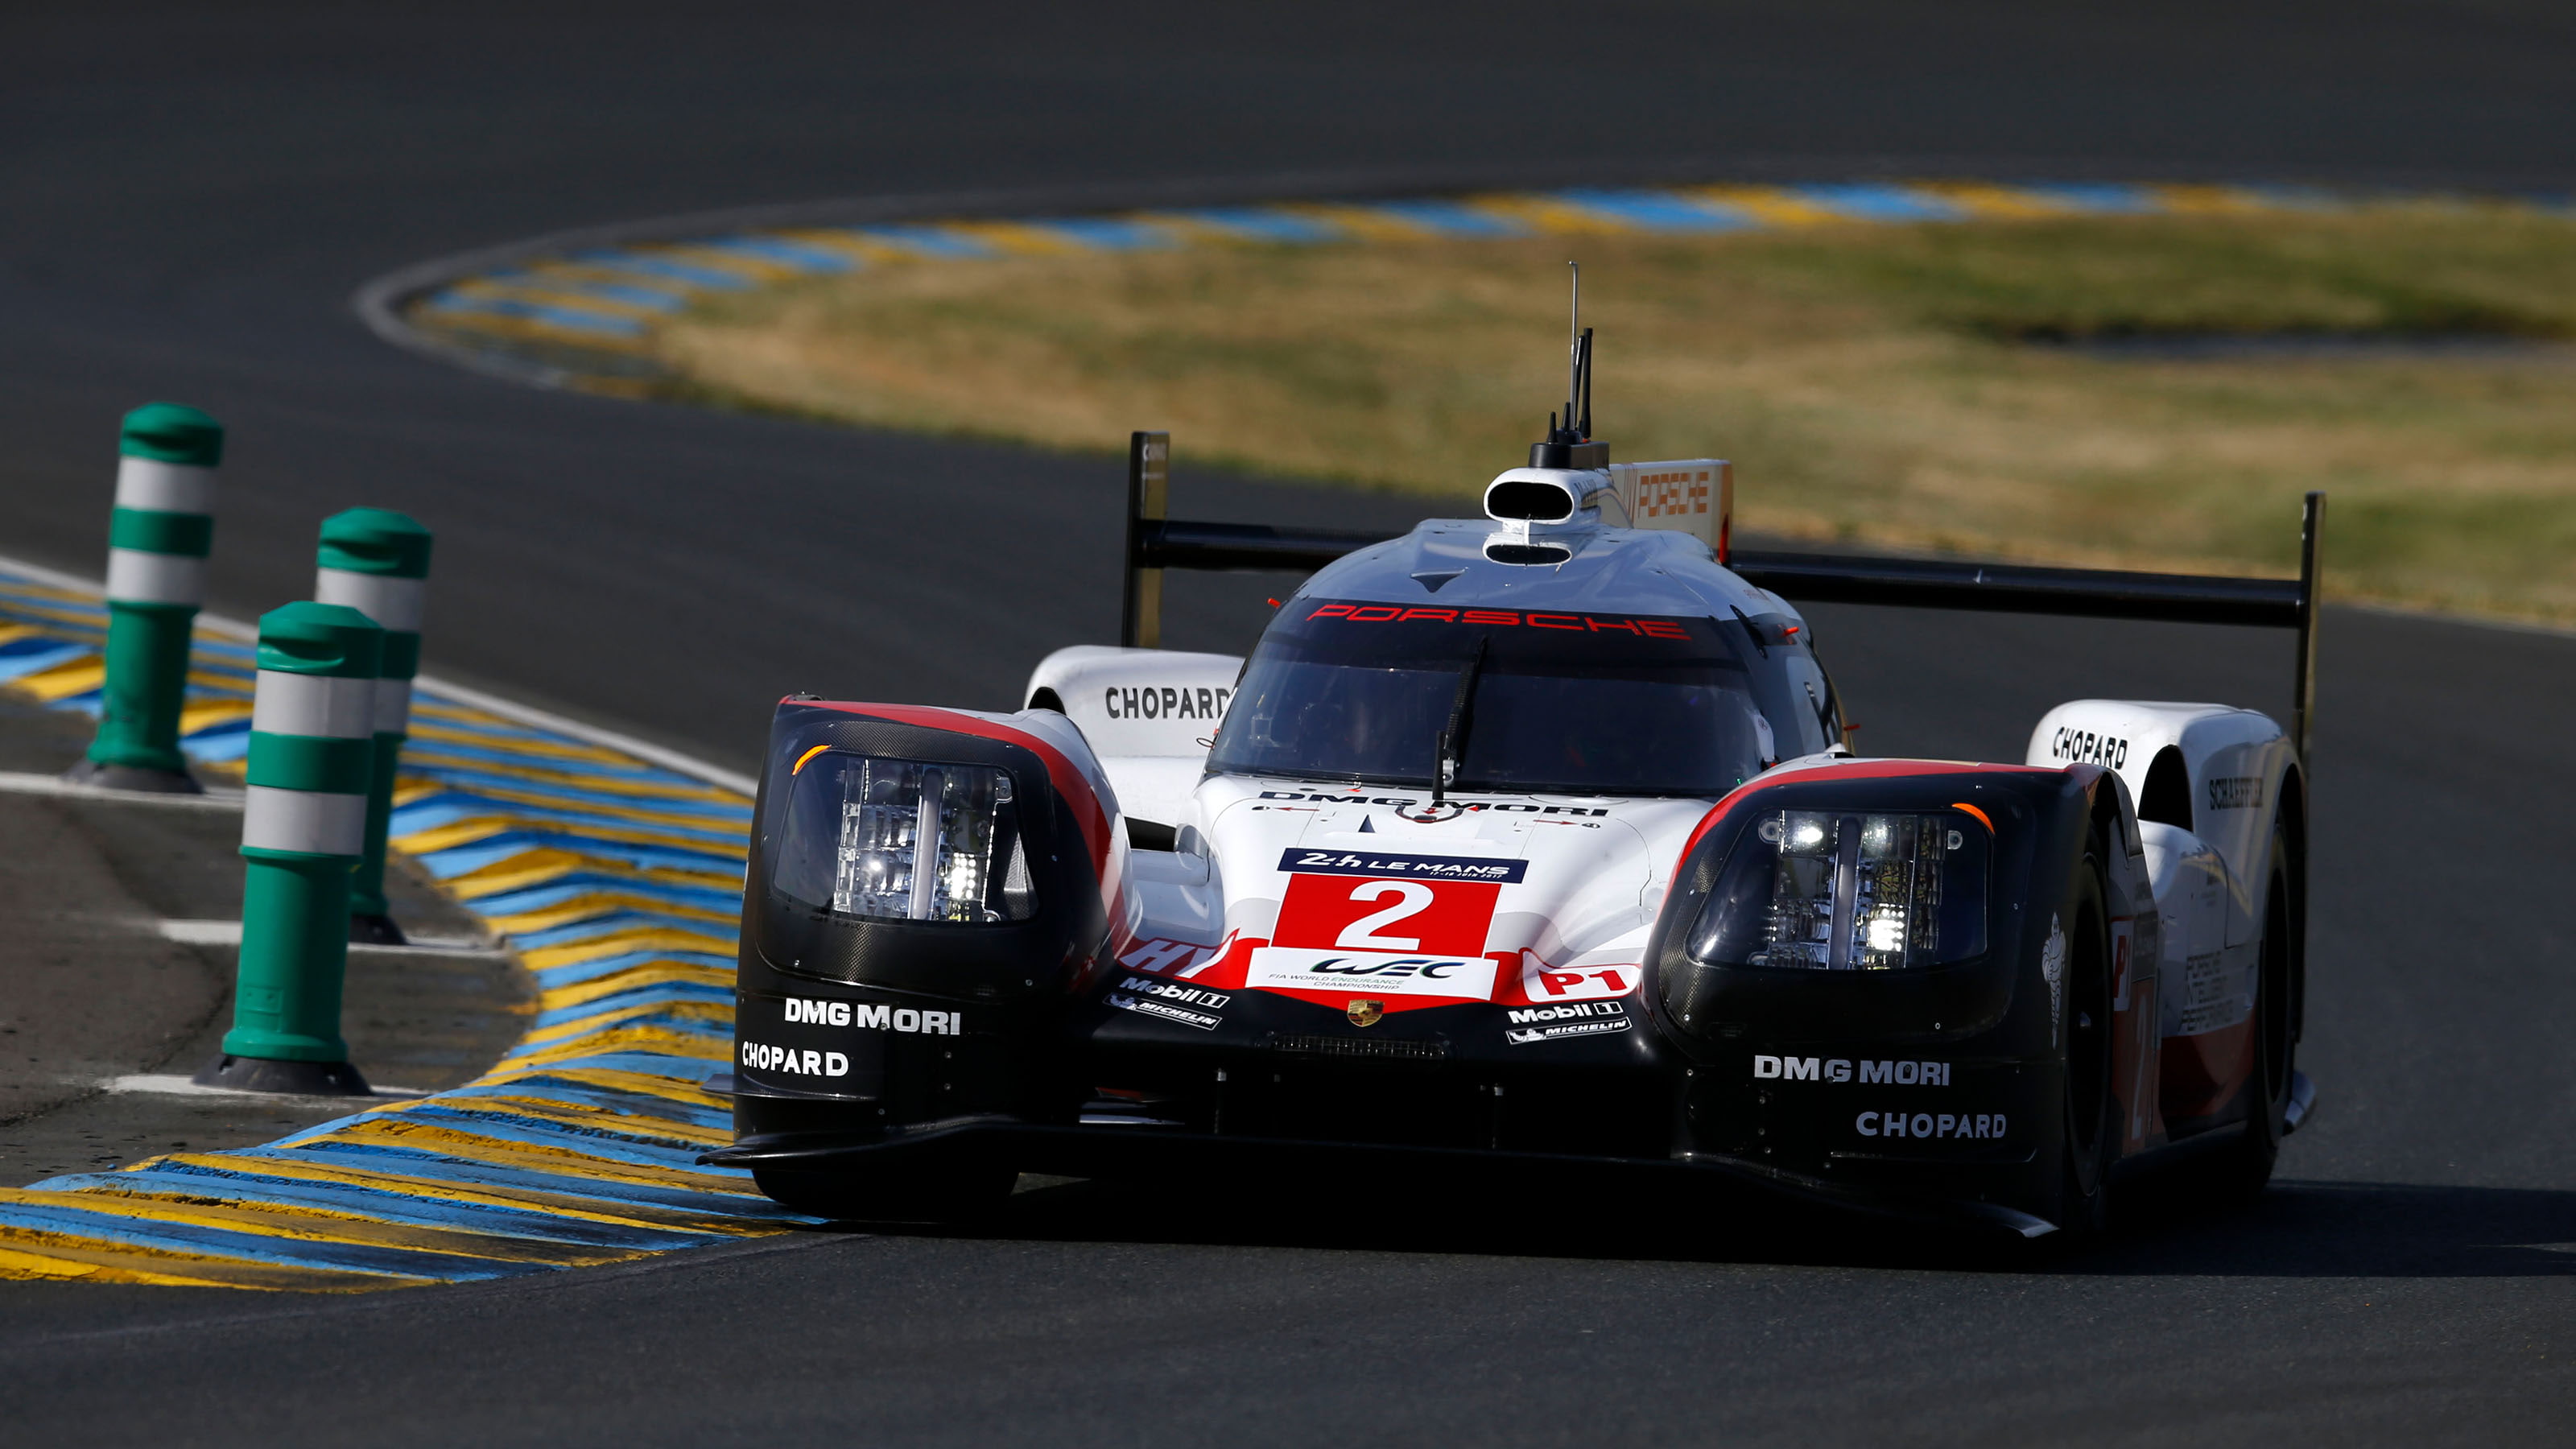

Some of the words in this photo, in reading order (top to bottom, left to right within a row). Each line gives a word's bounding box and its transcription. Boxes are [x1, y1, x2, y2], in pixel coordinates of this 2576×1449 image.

[1638, 472, 1709, 518] PORSCHE
[1305, 604, 1692, 641] PORSCHE
[1106, 687, 1231, 719] CHOPARD
[2053, 726, 2128, 770] CHOPARD
[1258, 791, 1418, 806] DMG
[1430, 800, 1608, 816] MORI
[1368, 861, 1410, 870] LE
[1414, 863, 1510, 875] MANS
[1335, 880, 1435, 951] 2
[1290, 974, 1329, 982] WORLD
[1331, 976, 1405, 985] ENDURANCE
[1309, 958, 1467, 979] WEC
[1119, 976, 1202, 1002] Mobil
[1313, 981, 1400, 990] CHAMPIONSHIP
[1538, 970, 1628, 995] P1
[784, 997, 851, 1026] DMG
[857, 1004, 960, 1035] MORI
[1139, 1001, 1217, 1025] MICHELIN
[1508, 1004, 1592, 1024] Mobil
[1545, 1020, 1627, 1035] MICHELIN
[742, 1041, 848, 1077] CHOPARD
[1754, 1055, 1852, 1082] DMG
[1859, 1059, 1950, 1086] MORI
[1856, 1112, 2006, 1138] CHOPARD
